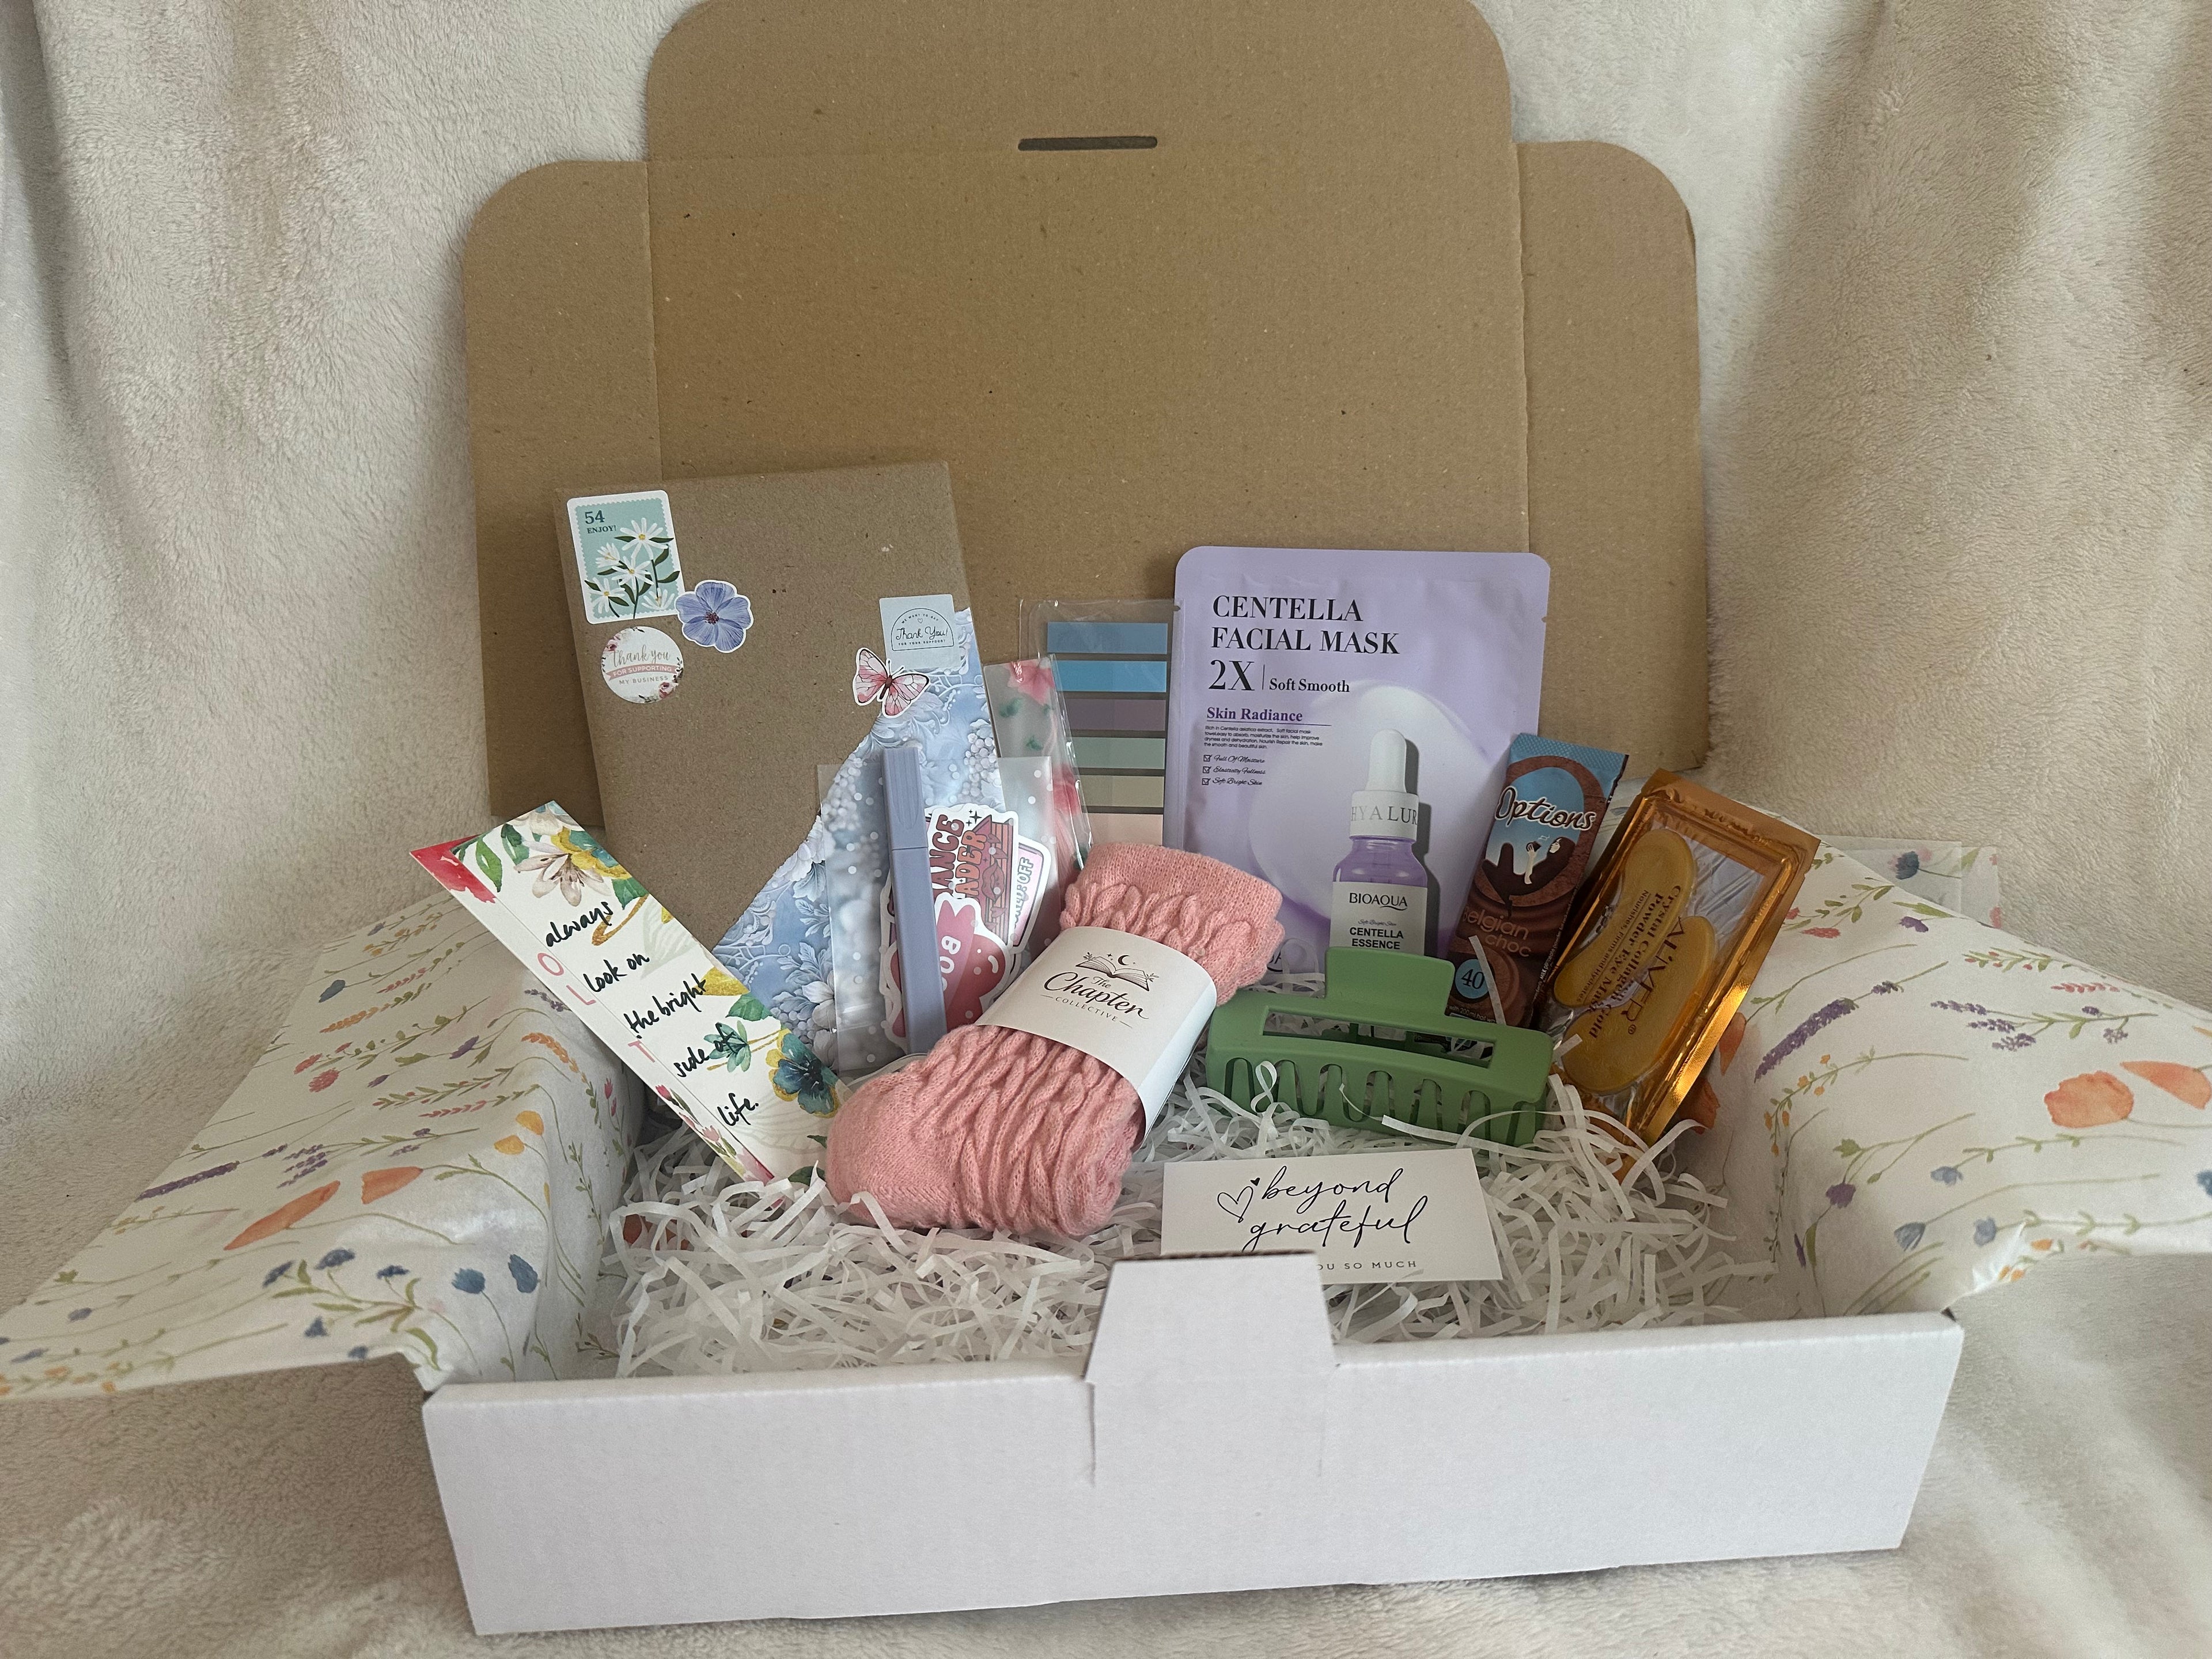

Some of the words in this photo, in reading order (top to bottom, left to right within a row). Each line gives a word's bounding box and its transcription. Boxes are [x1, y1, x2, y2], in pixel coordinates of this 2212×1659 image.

[585, 510, 605, 524] 54
[586, 525, 617, 534] ENJOY!
[1213, 595, 1363, 622] CENTELLA
[896, 627, 923, 640] Thank
[925, 626, 948, 640] You!
[1211, 627, 1311, 651] FACIAL
[1319, 630, 1400, 654] MASK
[650, 649, 671, 665] you
[612, 669, 627, 677] FOR
[632, 676, 669, 684] BUSINESS
[1209, 660, 1255, 691] 2X
[1269, 677, 1296, 691] Soft
[1298, 679, 1350, 692] Smooth
[1207, 707, 1236, 720] Skin
[1241, 708, 1303, 722] Radiance
[1495, 786, 1596, 830] Options
[1017, 857, 1034, 884] OFF
[1349, 892, 1408, 910] BIOAQUA
[1647, 885, 1681, 937] Crystal
[546, 902, 613, 947] always
[1350, 927, 1404, 939] CENTELLA
[1463, 909, 1529, 940] Belgian
[1629, 893, 1664, 946] Powder
[1351, 938, 1400, 949] ESSENCE
[1484, 934, 1531, 957] choc
[626, 953, 650, 970] on
[1610, 949, 1630, 974] Eye
[1610, 940, 1649, 1000] Collagen
[1091, 976, 1112, 989] The
[1461, 968, 1485, 989] 40
[623, 1010, 660, 1033] the
[652, 973, 706, 1013] bright
[1044, 972, 1149, 1020] Chapter
[1588, 977, 1612, 1013] Mask
[1055, 996, 1118, 1022] COLLECTIVE
[1589, 1003, 1612, 1038] Gold
[673, 1047, 710, 1077] side
[713, 1022, 738, 1054] of
[717, 1093, 759, 1126] life.
[1262, 1165, 1404, 1214] beyond
[1242, 1195, 1428, 1252] grateful
[1372, 1260, 1416, 1269] MUCH
